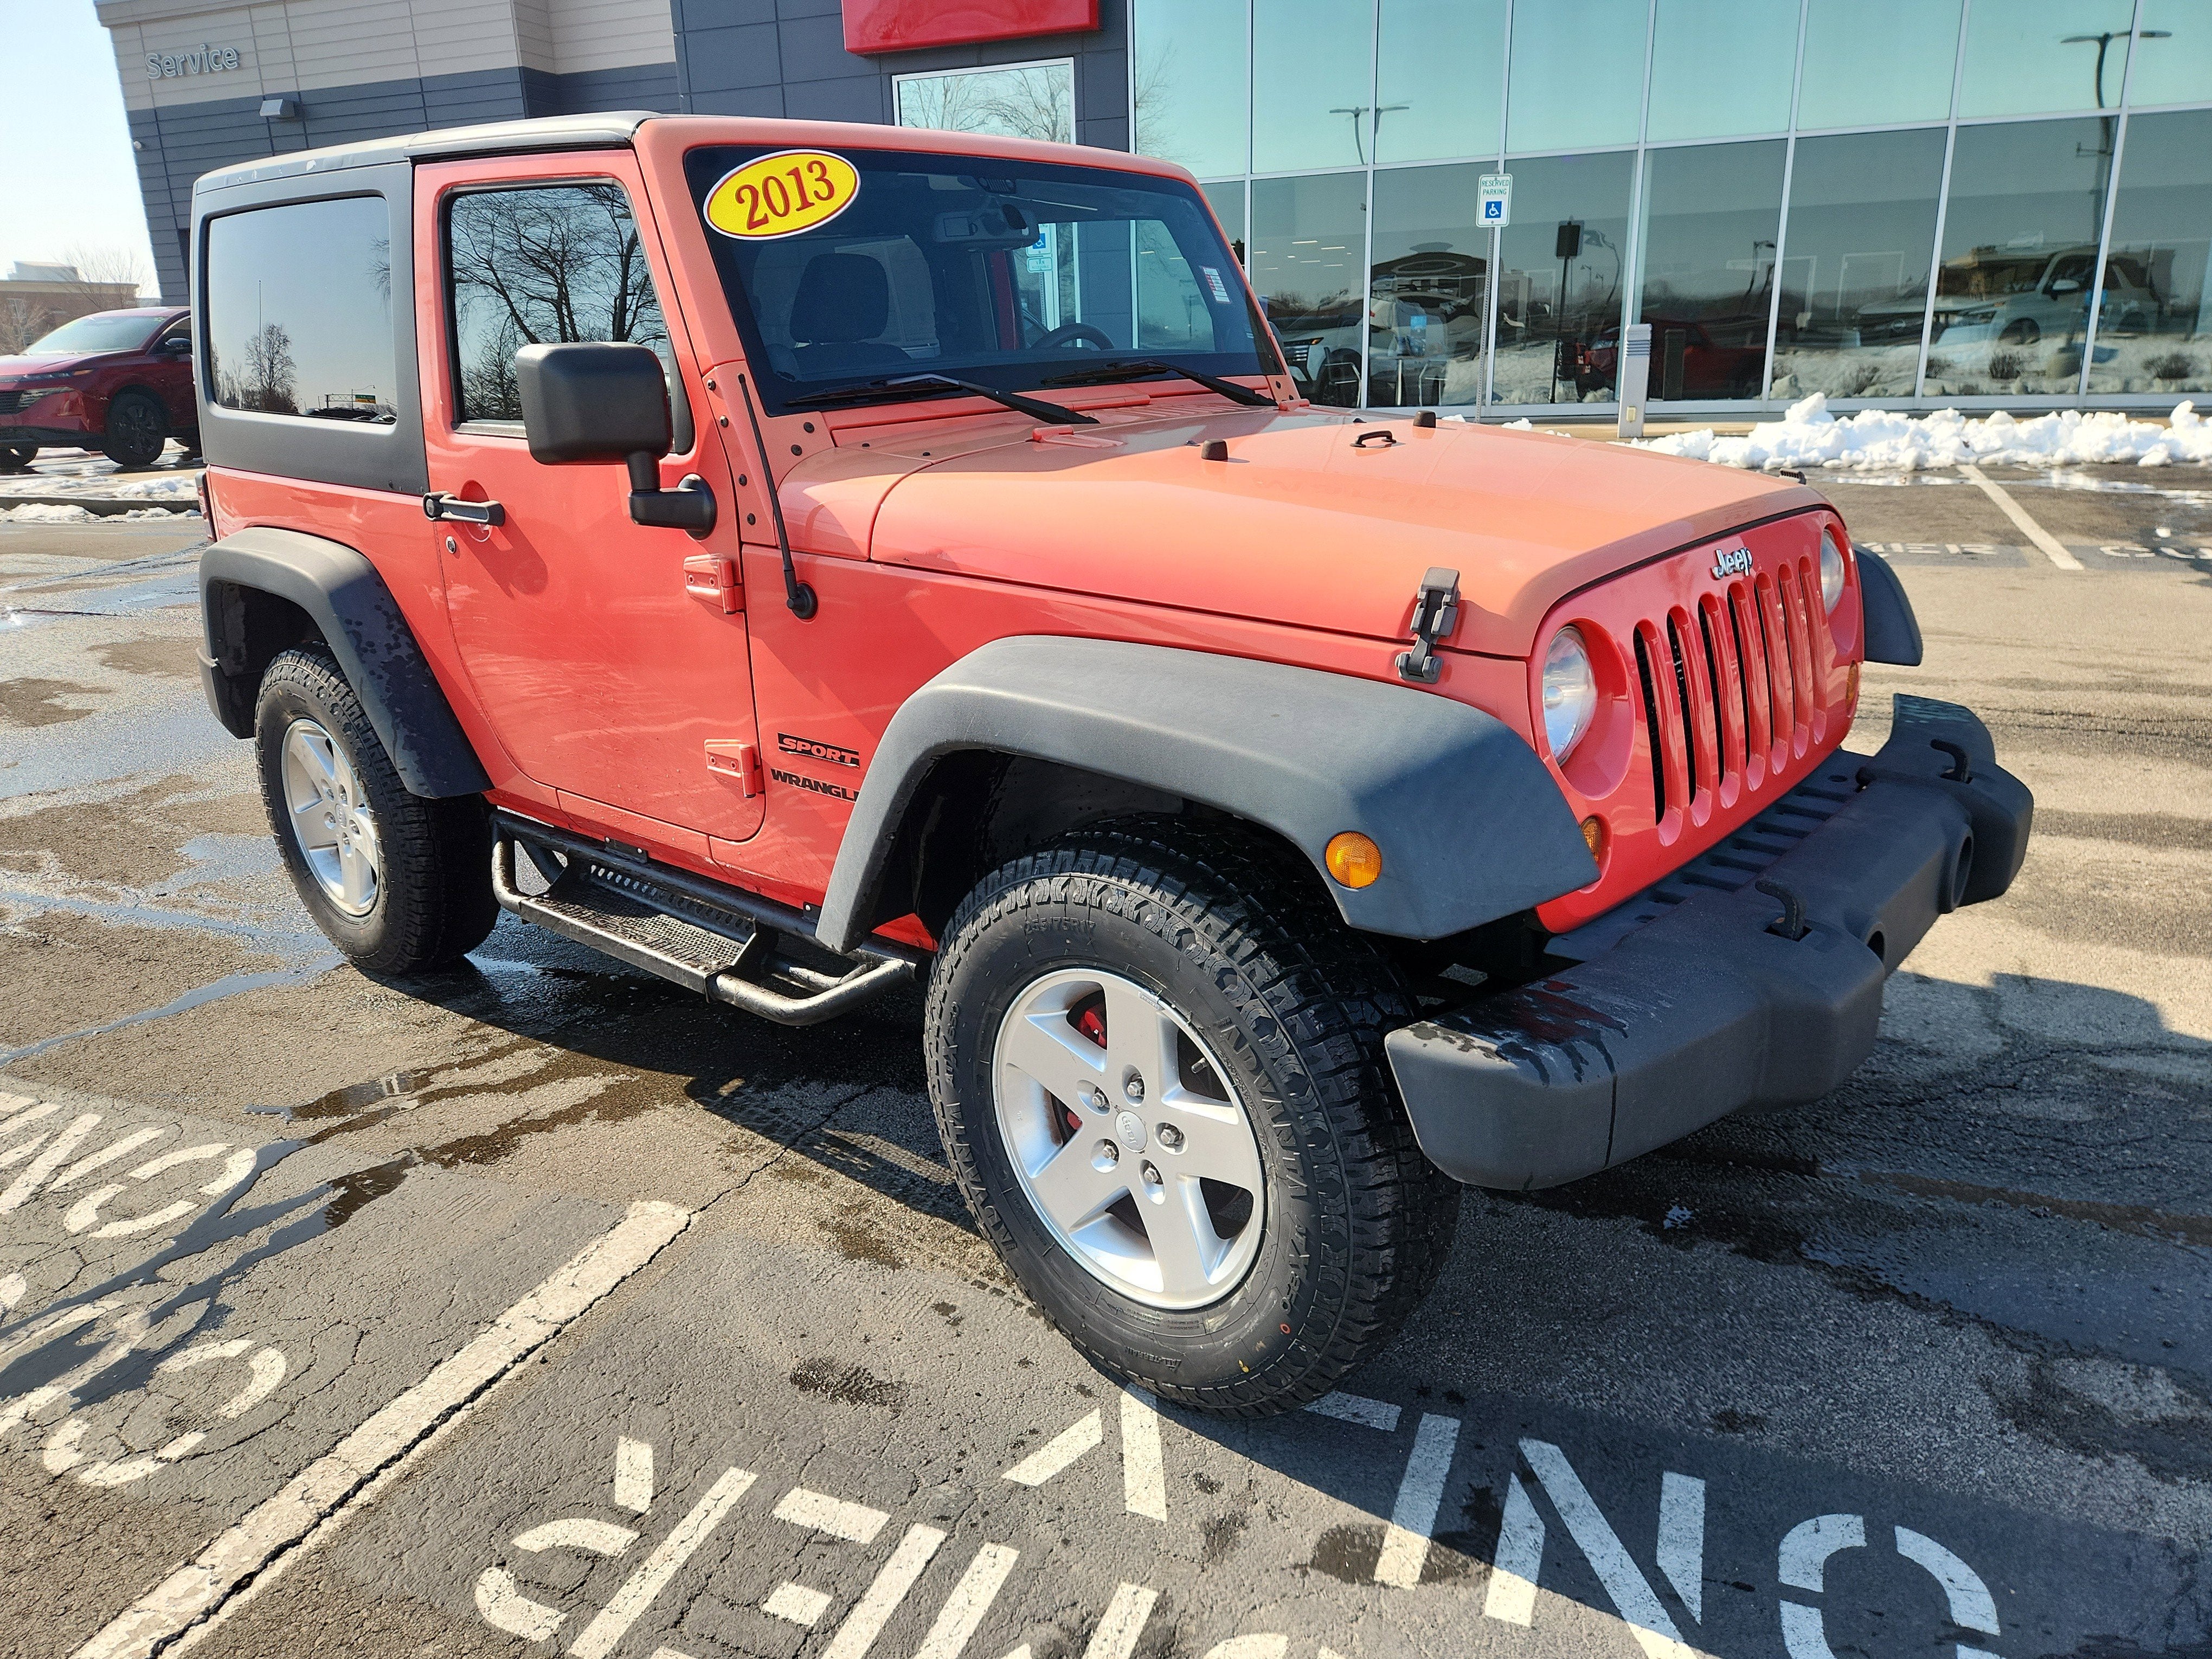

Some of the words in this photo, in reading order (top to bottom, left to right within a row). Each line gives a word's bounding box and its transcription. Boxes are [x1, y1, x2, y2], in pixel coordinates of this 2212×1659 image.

[145, 44, 238, 79] Service
[735, 160, 834, 230] 2013
[1712, 546, 1753, 580] Jeep
[779, 737, 860, 764] SPORT
[1221, 1025, 1308, 1197] ADVANTA
